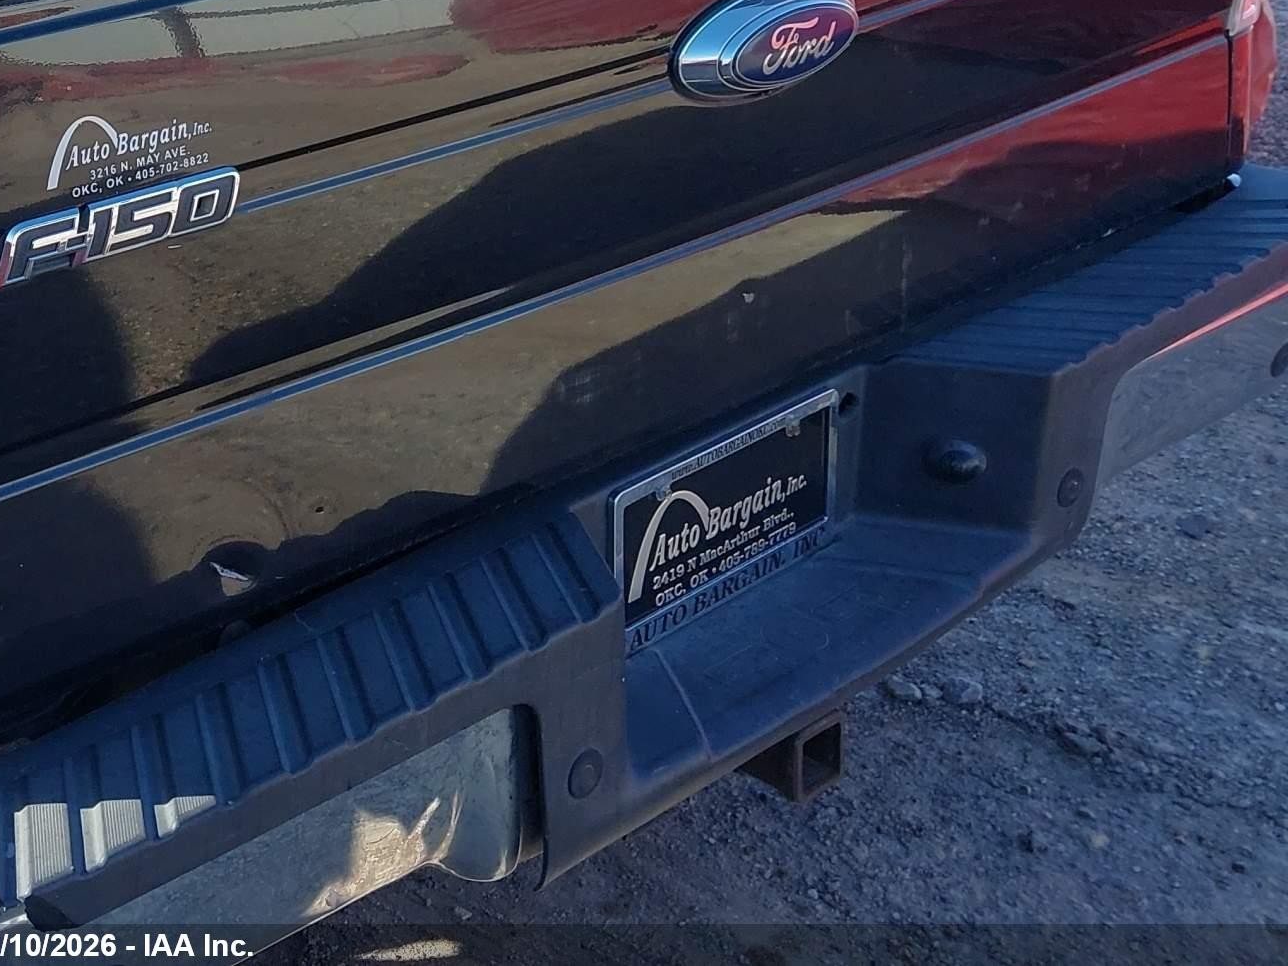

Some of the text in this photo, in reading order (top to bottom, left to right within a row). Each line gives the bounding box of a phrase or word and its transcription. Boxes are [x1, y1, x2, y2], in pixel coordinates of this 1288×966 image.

[763, 17, 837, 75] Ford
[65, 141, 110, 171] Auto
[72, 152, 209, 198] OKC, OK 405-702-8822
[89, 145, 191, 180] 3216 N. MAY AVE.
[650, 523, 699, 572] Auto
[652, 564, 685, 590] 2419
[686, 556, 698, 573] N
[699, 525, 761, 566] MacArthur
[655, 521, 797, 607] OKC, OK 405-789-7779
[629, 604, 688, 651] AUTO
